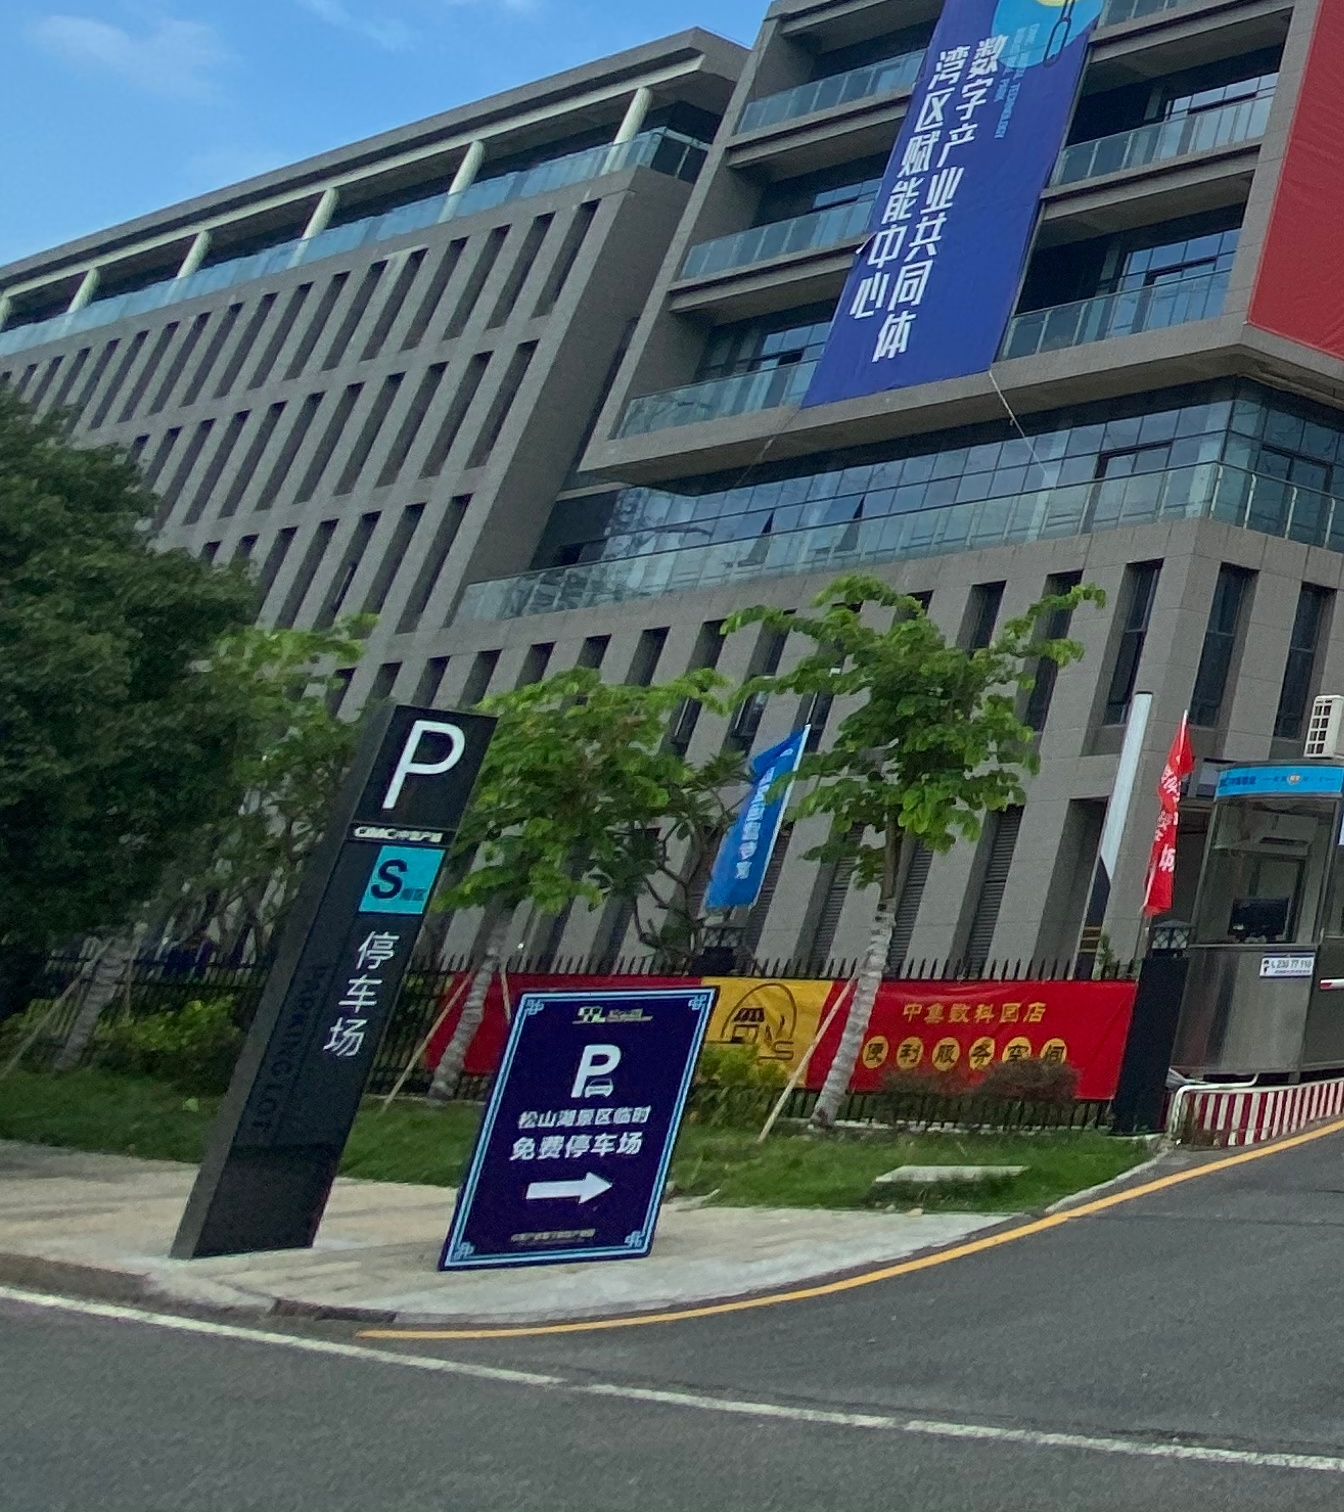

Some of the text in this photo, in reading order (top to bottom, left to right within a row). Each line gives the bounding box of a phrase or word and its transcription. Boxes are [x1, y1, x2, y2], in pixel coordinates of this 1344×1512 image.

[849, 44, 971, 321] 湾区赋能中心
[872, 34, 1009, 363] 数字产业共同体
[381, 719, 466, 809] P
[370, 859, 409, 900] S
[322, 930, 401, 1058] 停车场
[902, 1001, 1048, 1025] 中集数科园店
[570, 1044, 622, 1099] P
[862, 1040, 1068, 1067] 便利服务空间
[518, 1105, 652, 1130] 松山湖景区临时
[509, 1131, 644, 1162] 免费停车场
